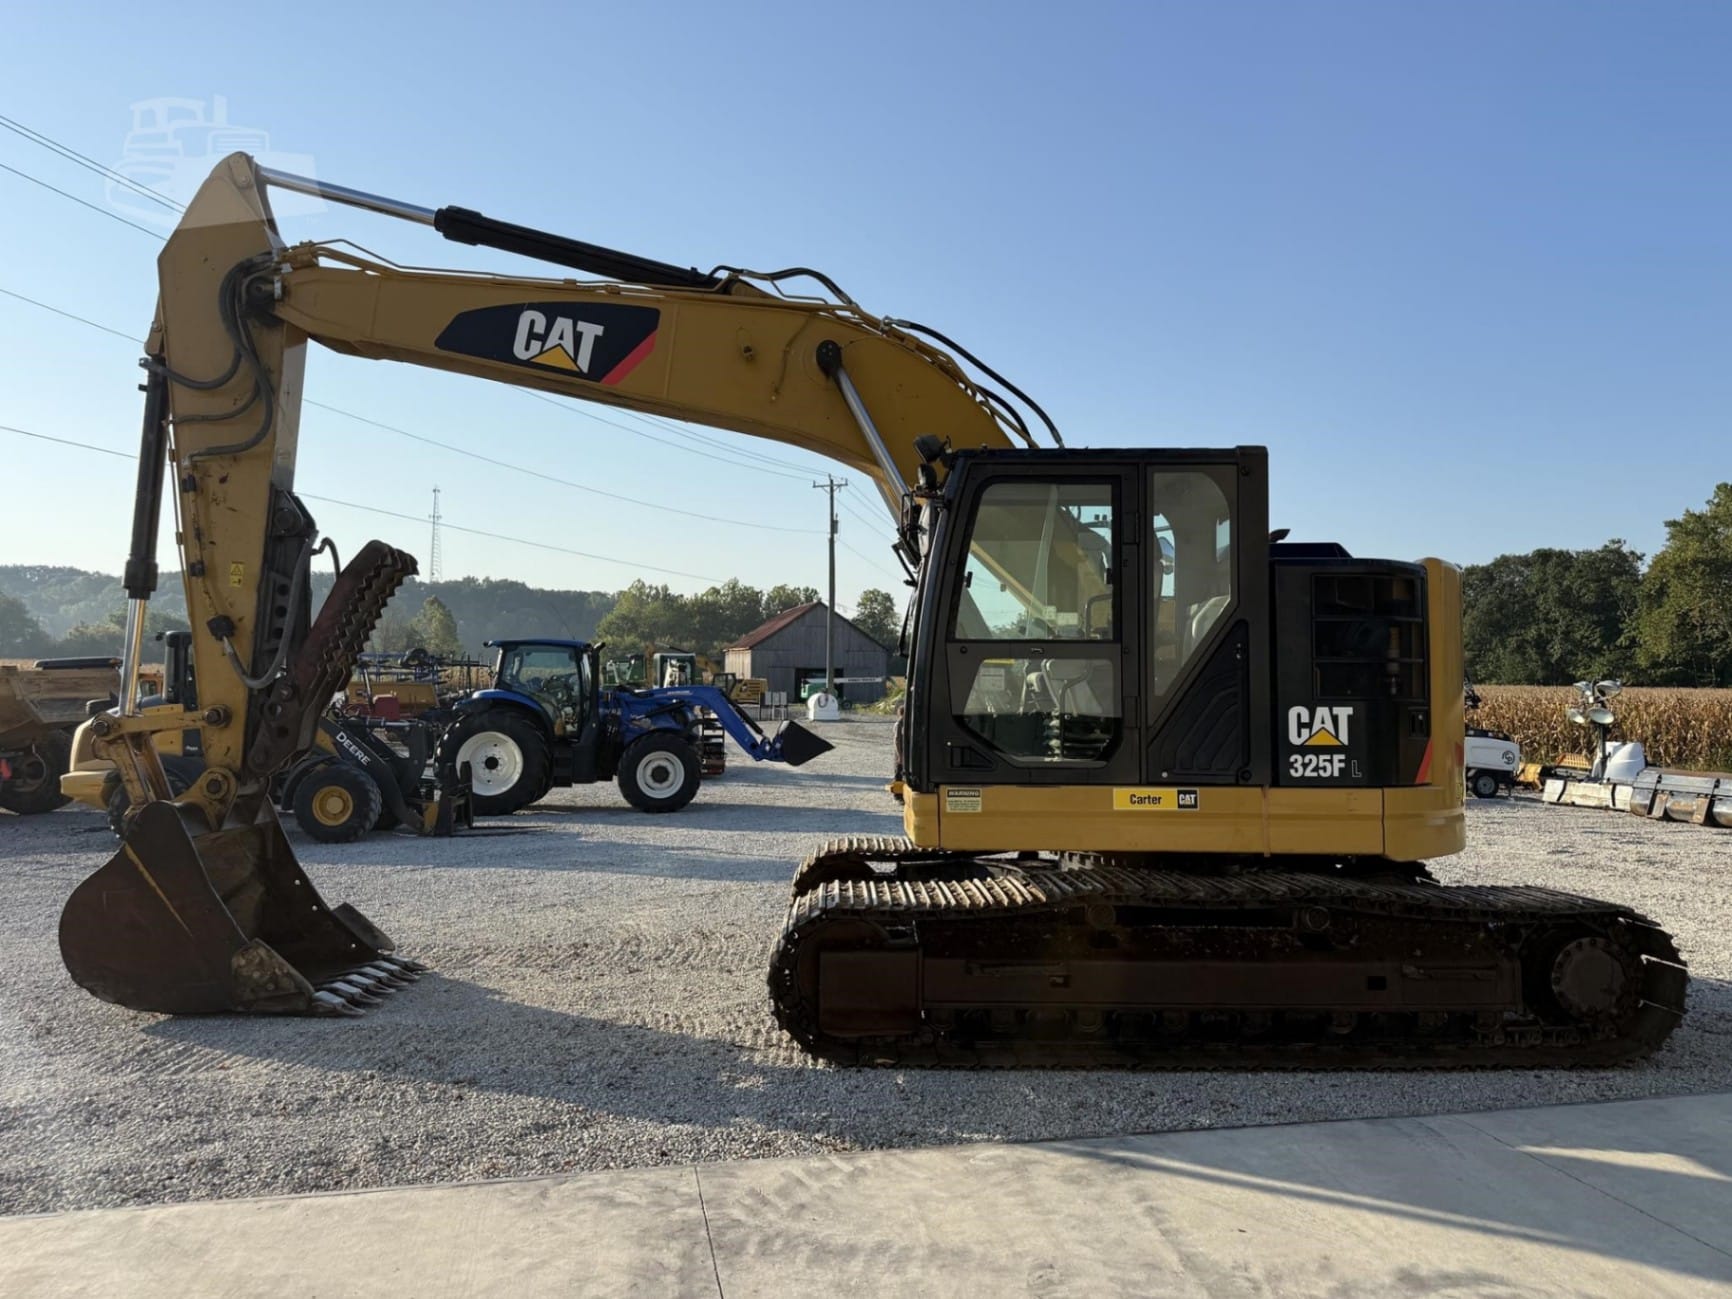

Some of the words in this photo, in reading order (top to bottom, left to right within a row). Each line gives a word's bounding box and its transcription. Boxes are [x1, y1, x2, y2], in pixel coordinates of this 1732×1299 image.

[513, 310, 605, 374] CAT
[1288, 705, 1354, 746] CAT
[336, 731, 371, 767] DEERE
[1289, 754, 1346, 778] 325F
[1351, 759, 1363, 778] L
[1129, 793, 1163, 805] Carter
[1178, 793, 1197, 805] CAT
